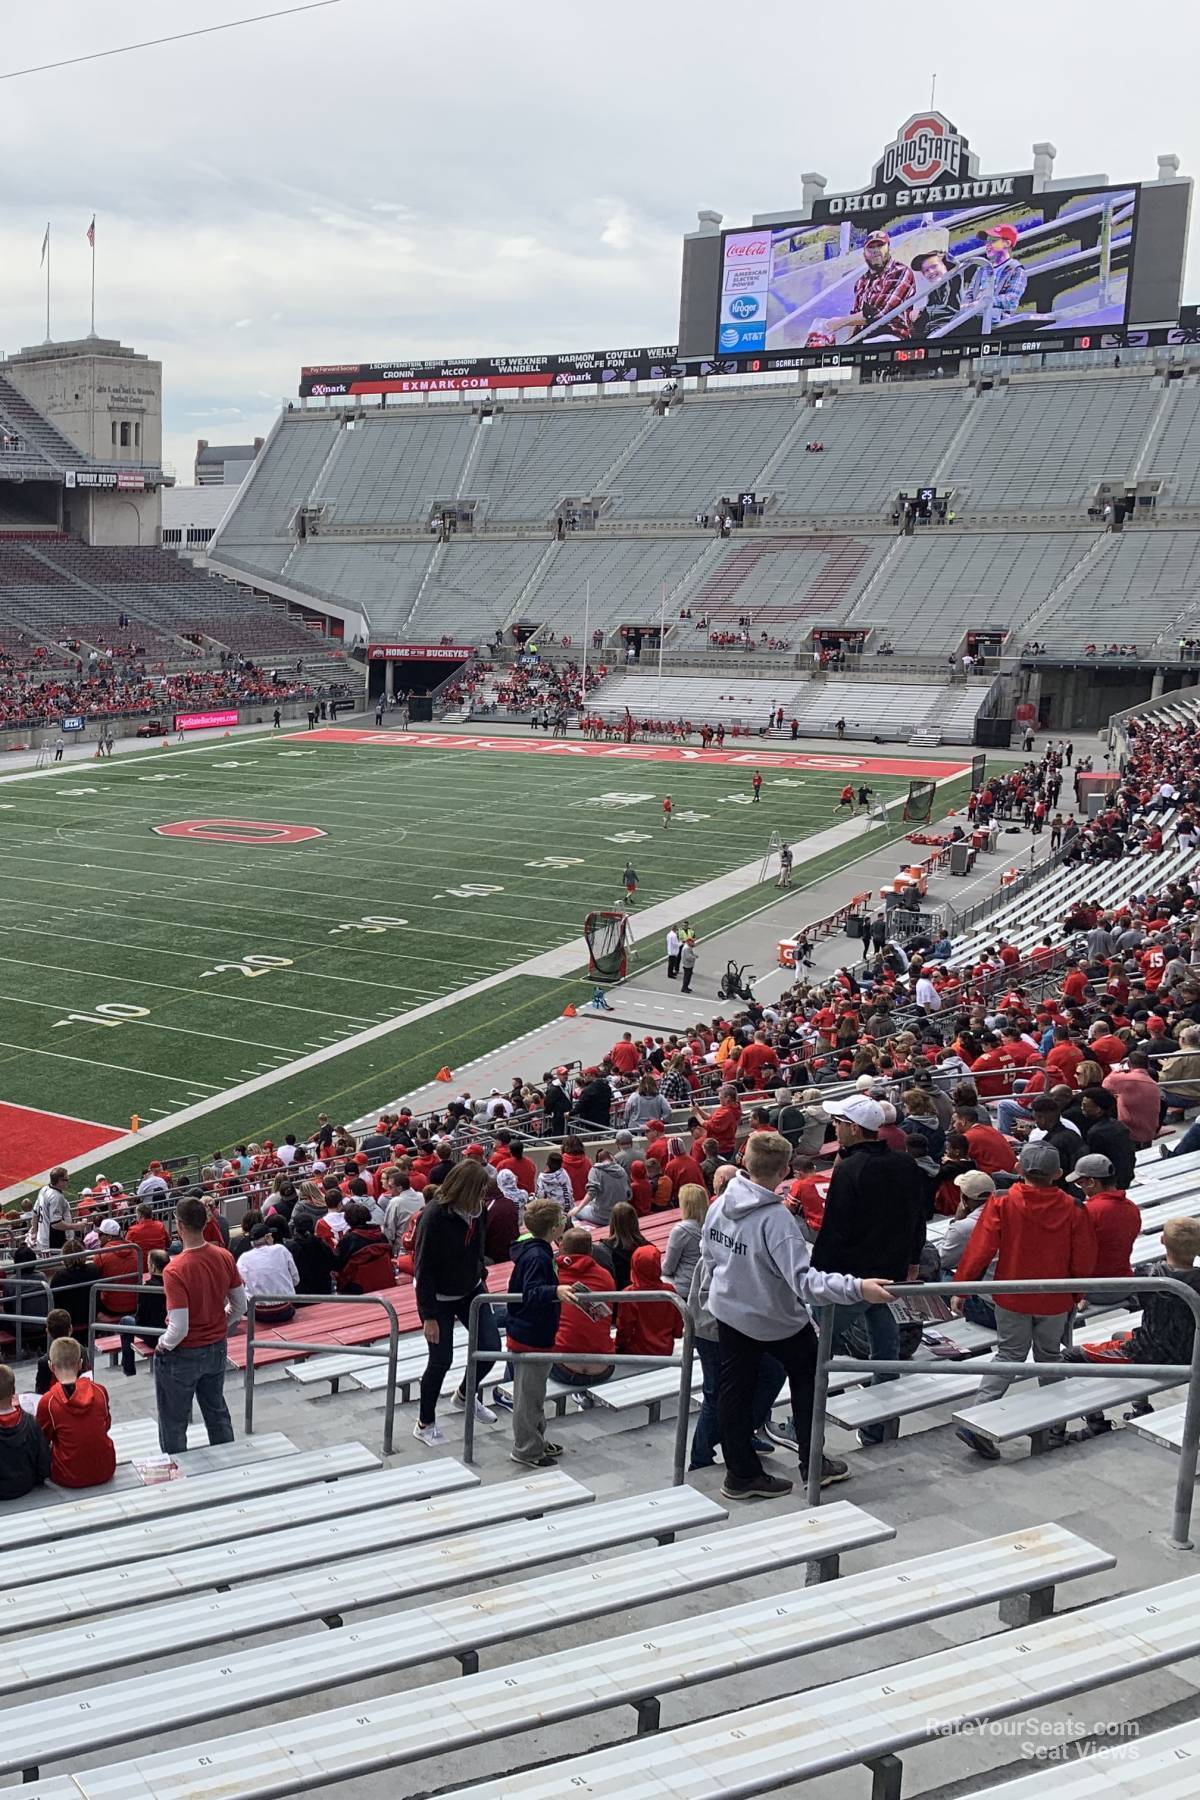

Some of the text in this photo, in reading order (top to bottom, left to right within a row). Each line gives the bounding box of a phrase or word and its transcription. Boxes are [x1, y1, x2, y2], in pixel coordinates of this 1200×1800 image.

[885, 133, 960, 181] OHIO STATE
[829, 178, 1015, 214] OHIO STADIUM
[732, 299, 757, 318] Kroger
[741, 332, 765, 342] AT&T
[1081, 336, 1090, 348] 0
[646, 347, 678, 357] WELLS
[1021, 341, 1041, 352] GRAY
[558, 354, 595, 364] HARMON
[605, 350, 641, 360] COVELLI
[832, 355, 839, 366] 0
[490, 356, 548, 367] LES WEXNER
[575, 359, 625, 370] WOLFE FDN
[752, 360, 759, 370] 0
[775, 358, 804, 369] SCARLET
[383, 370, 414, 379] CRONIN
[441, 368, 469, 377] McCOY
[498, 364, 541, 374] WANDELL
[402, 378, 489, 392] EXMARK.COM
[385, 648, 409, 658] HOME
[426, 648, 469, 658] BUCKEYES
[358, 734, 869, 768] BUCKEYES
[339, 915, 408, 934] 30
[213, 953, 293, 977] 20
[67, 1002, 150, 1027] 10
[882, 1687, 894, 1695] 17
[1174, 1749, 1191, 1759] 17
[199, 1757, 212, 1765] 13
[571, 1777, 587, 1785] 15
